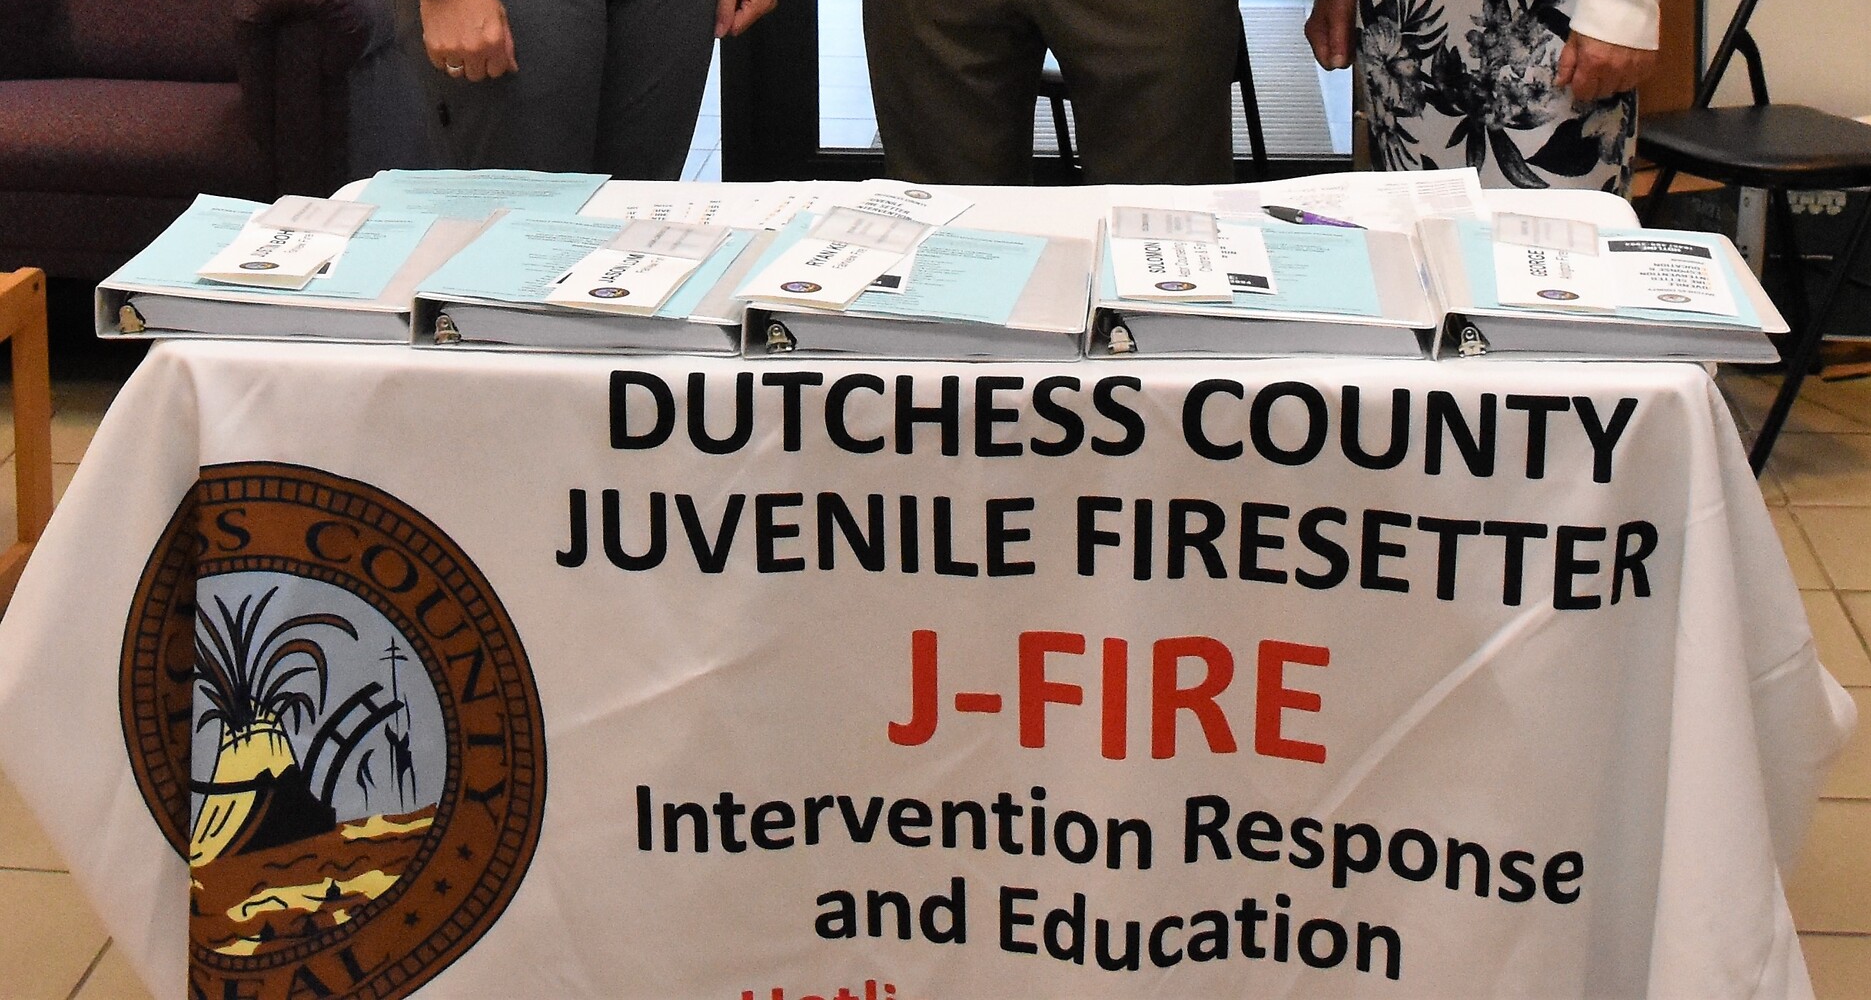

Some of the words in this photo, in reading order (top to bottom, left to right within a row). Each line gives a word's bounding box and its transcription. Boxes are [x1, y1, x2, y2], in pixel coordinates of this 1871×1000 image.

[868, 197, 903, 207] UVENILE
[805, 249, 839, 267] RYAN
[1143, 241, 1167, 274] SOLOMON
[1527, 249, 1548, 277] GEORGE
[1659, 267, 1707, 276] ESPONSE
[1669, 281, 1710, 291] UVENILE
[609, 370, 1146, 458] DUTCHESS
[1182, 378, 1639, 485] COUNTY
[555, 488, 1036, 578] JUVENILE
[1076, 495, 1660, 612] FIRESETTER
[304, 519, 508, 826] COUNTY
[888, 630, 1329, 763] J-FIRE
[636, 785, 1152, 870] Intervention
[1184, 794, 1584, 905] Response
[814, 876, 967, 945] and
[999, 885, 1401, 981] Education
